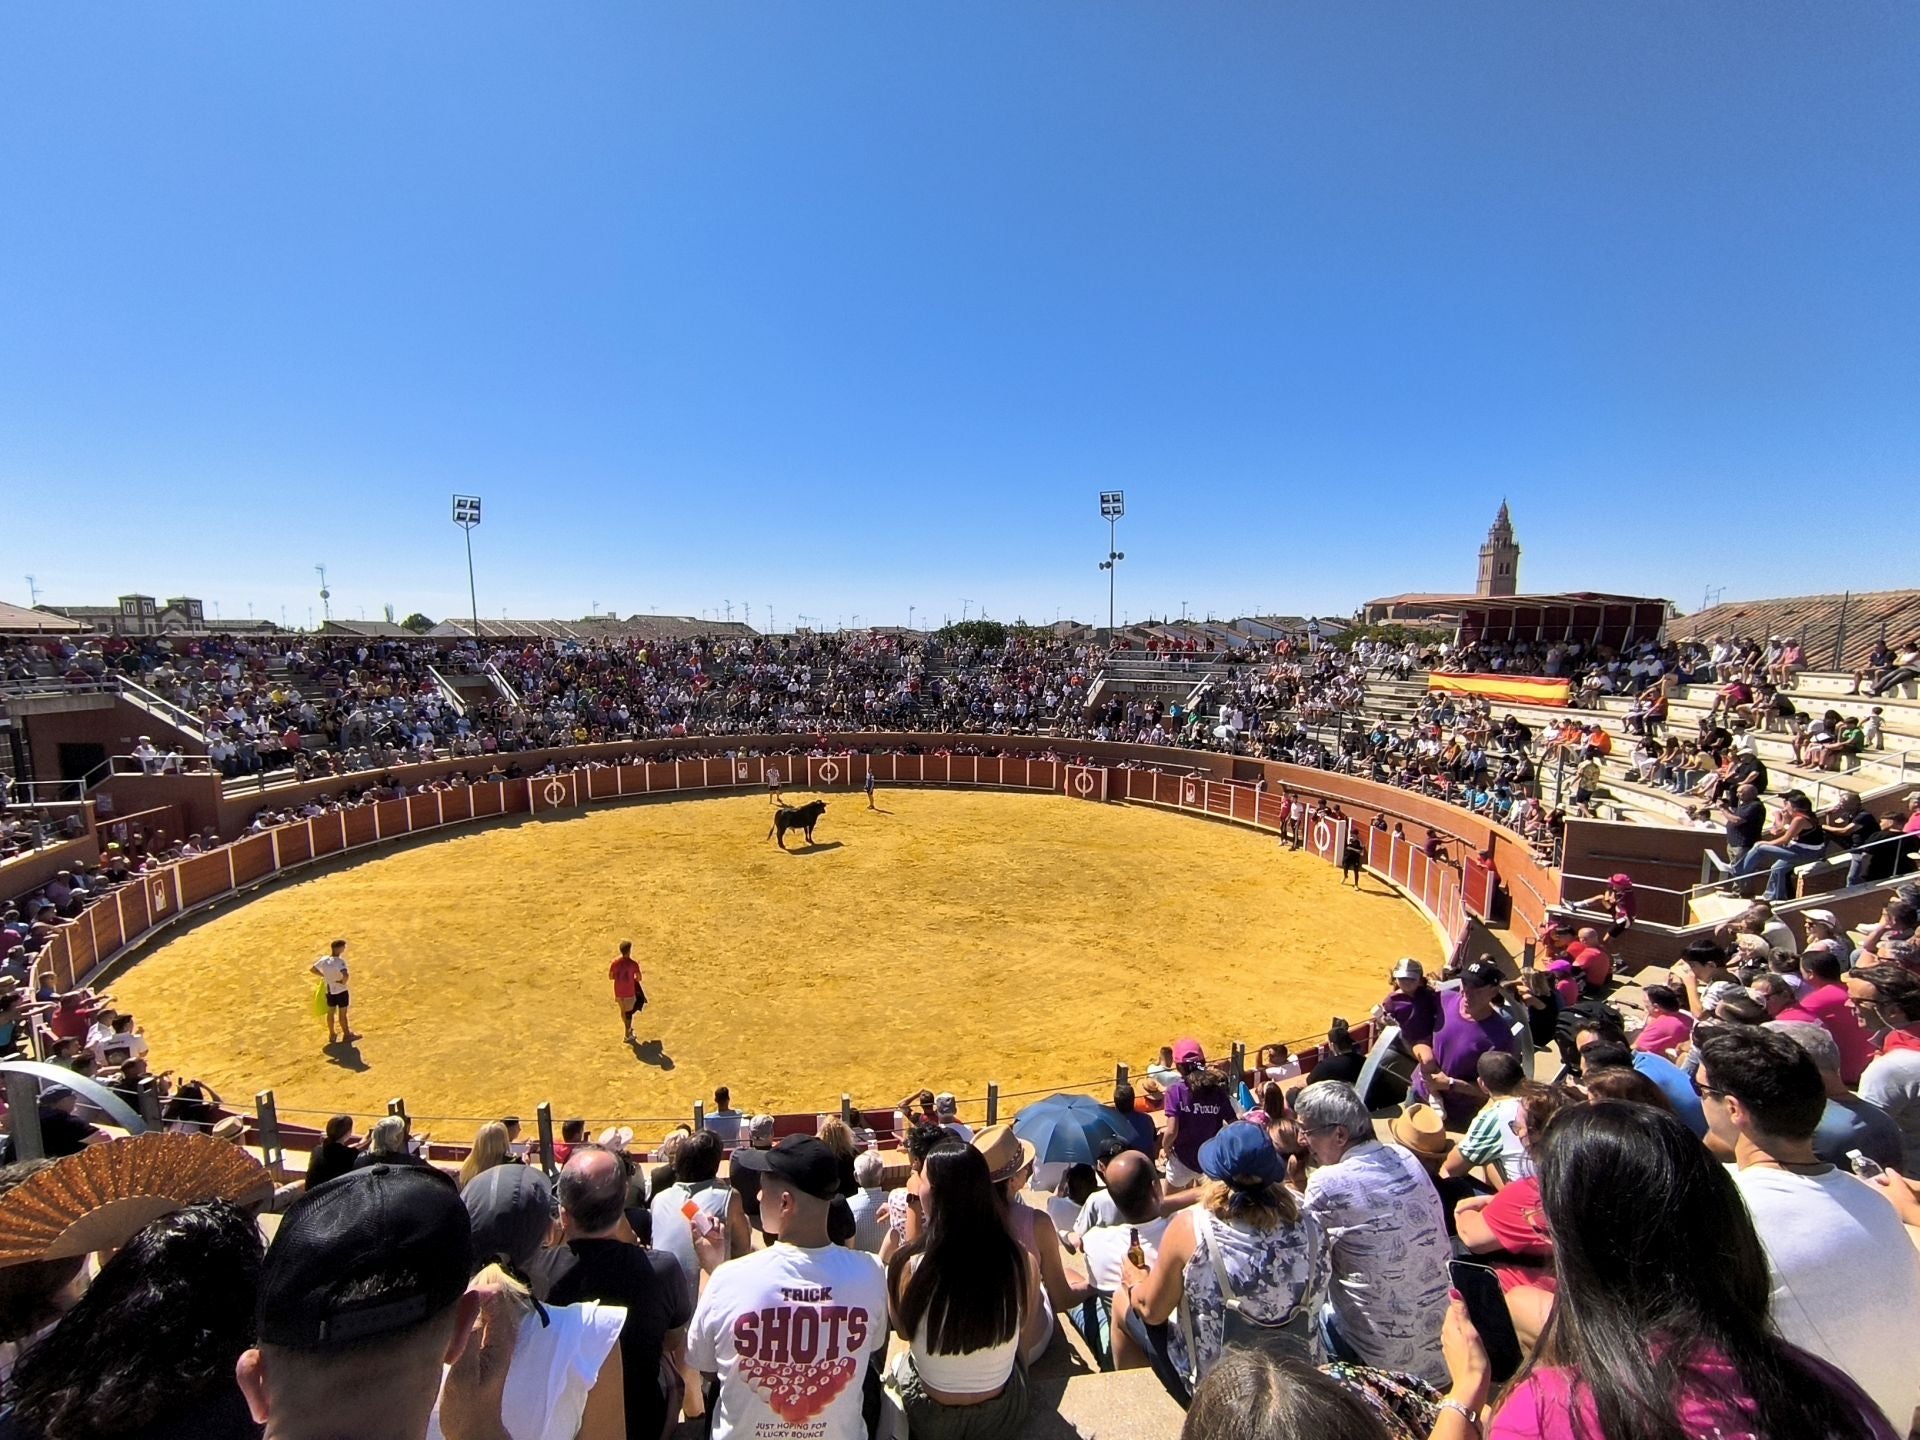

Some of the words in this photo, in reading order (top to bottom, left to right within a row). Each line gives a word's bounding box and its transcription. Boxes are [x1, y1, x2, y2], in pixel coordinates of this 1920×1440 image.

[1193, 1102, 1221, 1114] FUXIÓ
[781, 1287, 832, 1301] TRICK
[734, 1306, 868, 1363] SHOTS
[756, 1422, 774, 1430] JUST
[811, 1422, 827, 1430] FOR
